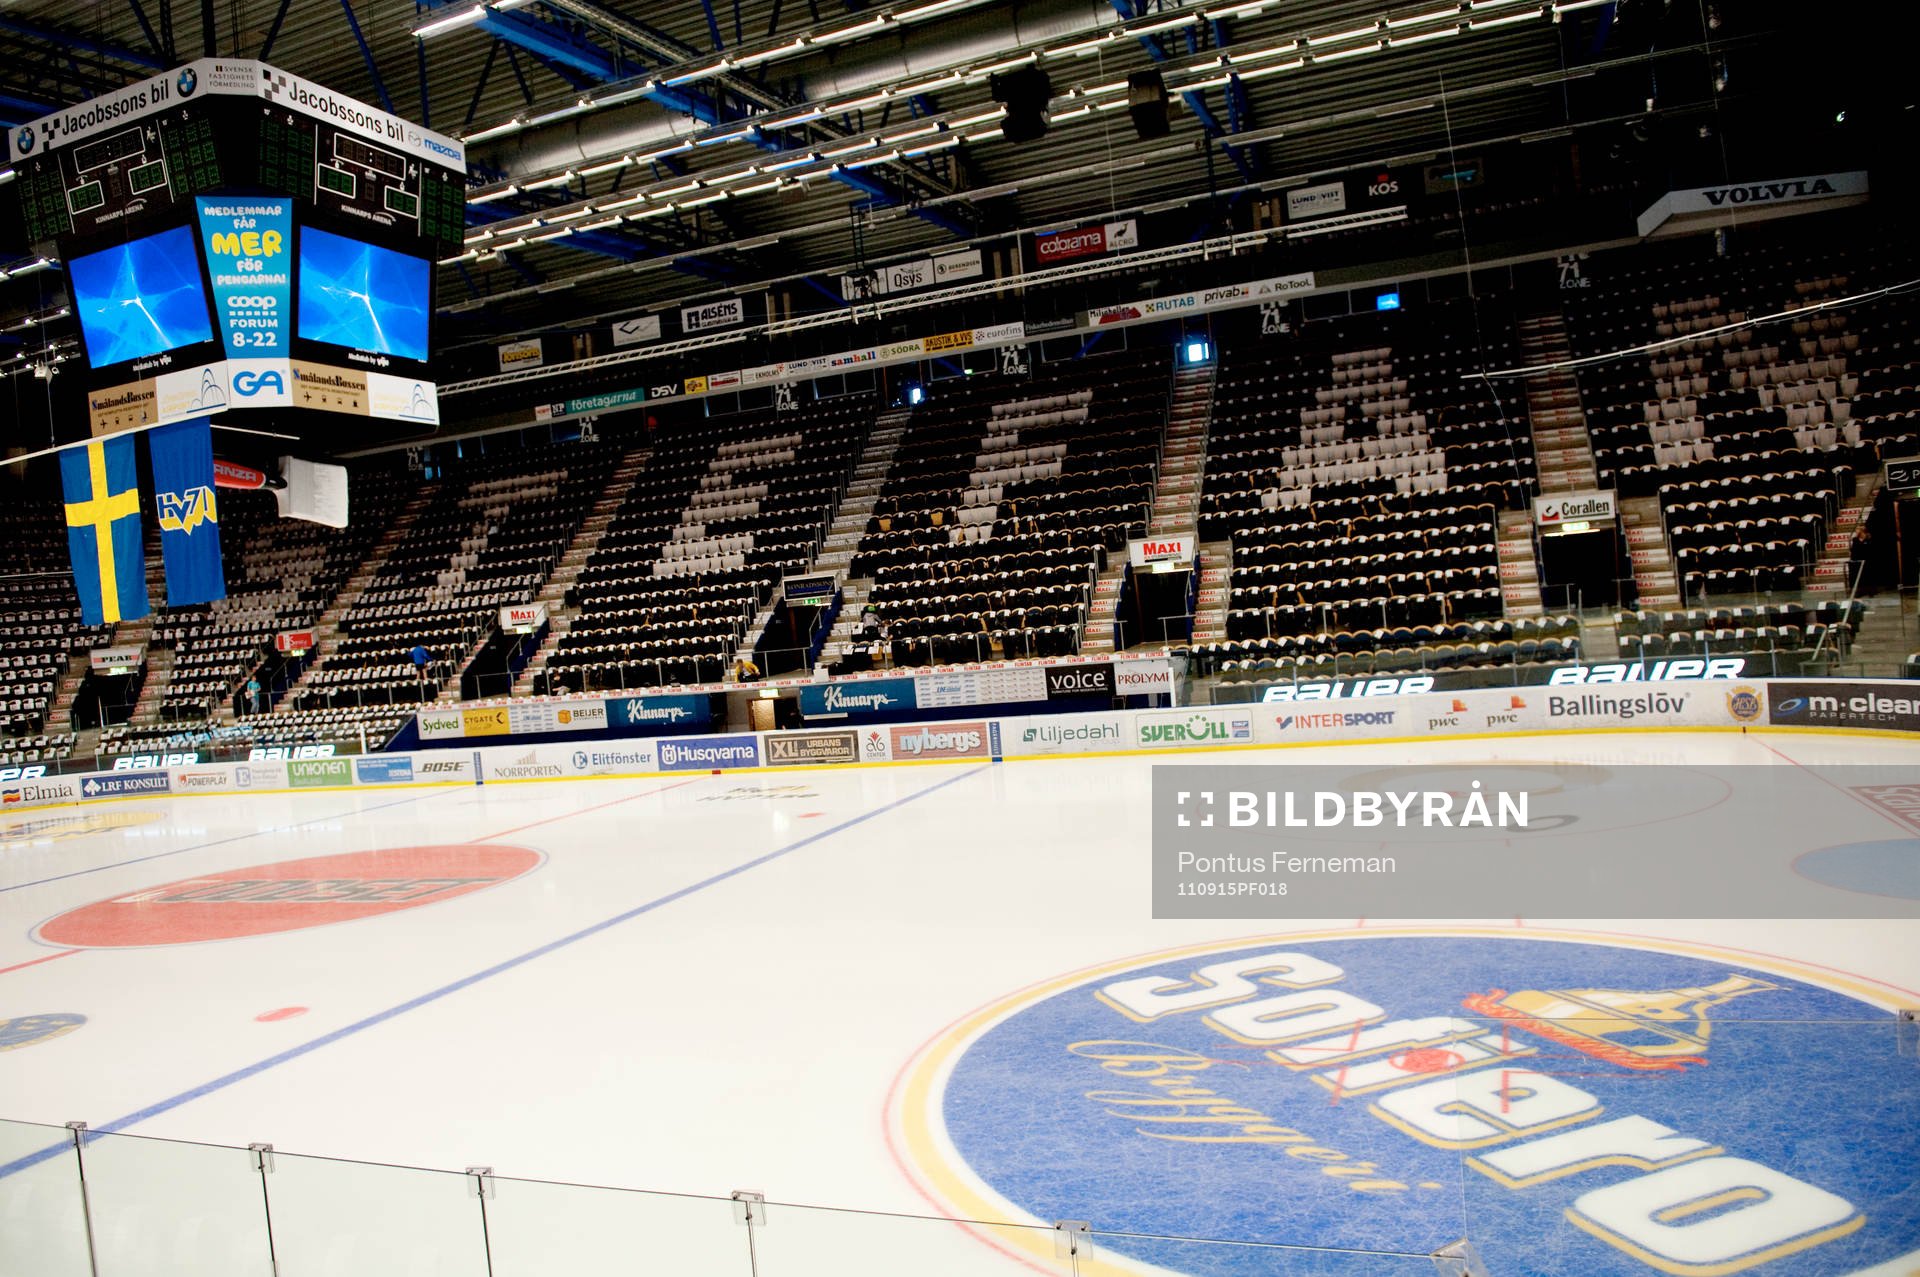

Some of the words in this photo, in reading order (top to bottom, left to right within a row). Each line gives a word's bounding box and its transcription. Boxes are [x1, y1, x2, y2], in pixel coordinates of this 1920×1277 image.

[62, 93, 147, 136] Jacobssons
[151, 79, 169, 104] bil
[289, 82, 383, 134] Jacobssons
[386, 119, 404, 142] bil
[423, 138, 462, 161] mazda
[1368, 181, 1399, 196] KOS
[1702, 178, 1837, 206] VOLVIA
[204, 205, 282, 216] MEDLEMMAR
[233, 216, 256, 229] FÅR
[211, 229, 282, 257] MER
[1040, 232, 1102, 254] colorama
[236, 258, 263, 272] FÖR
[217, 273, 286, 285] PENGARNA!
[894, 272, 923, 288] Qsys
[227, 295, 277, 310] coop
[1204, 286, 1240, 304] privab
[1155, 296, 1195, 311] RUTAB
[229, 319, 278, 328] FORUM
[232, 332, 278, 347] 8-22
[986, 327, 1022, 338] eurofins
[891, 343, 920, 355] SÖDRA
[831, 351, 876, 366] samhall
[232, 370, 284, 396] GA
[651, 383, 678, 398] DSV
[571, 391, 637, 411] företagarna
[1561, 499, 1610, 516] Corallen
[1050, 670, 1105, 689] voice
[823, 686, 898, 711] Kinnarps
[1549, 693, 1685, 718] Ballingslöv
[573, 708, 604, 718] BEIJER
[627, 699, 692, 723] Kinnarps
[1809, 711, 1896, 721] PAPERTECH
[423, 717, 459, 733] Sydved
[463, 715, 493, 724] CYGATE
[1295, 711, 1395, 729] INTERSPORT
[1428, 715, 1459, 730] pwc
[1486, 713, 1518, 727] pwc
[900, 727, 981, 754] nybergs
[1040, 723, 1119, 744] Liljedahl
[806, 738, 841, 747] URBANS
[678, 746, 754, 763] Husqvarna
[800, 747, 849, 756] BYGGVAROR
[422, 761, 465, 773] BOSE
[592, 753, 651, 766] Elitfönster
[494, 765, 562, 778] NORRPORTEN
[101, 782, 122, 792] LRF
[124, 777, 168, 790] KONSULT
[22, 784, 73, 801] Elmia
